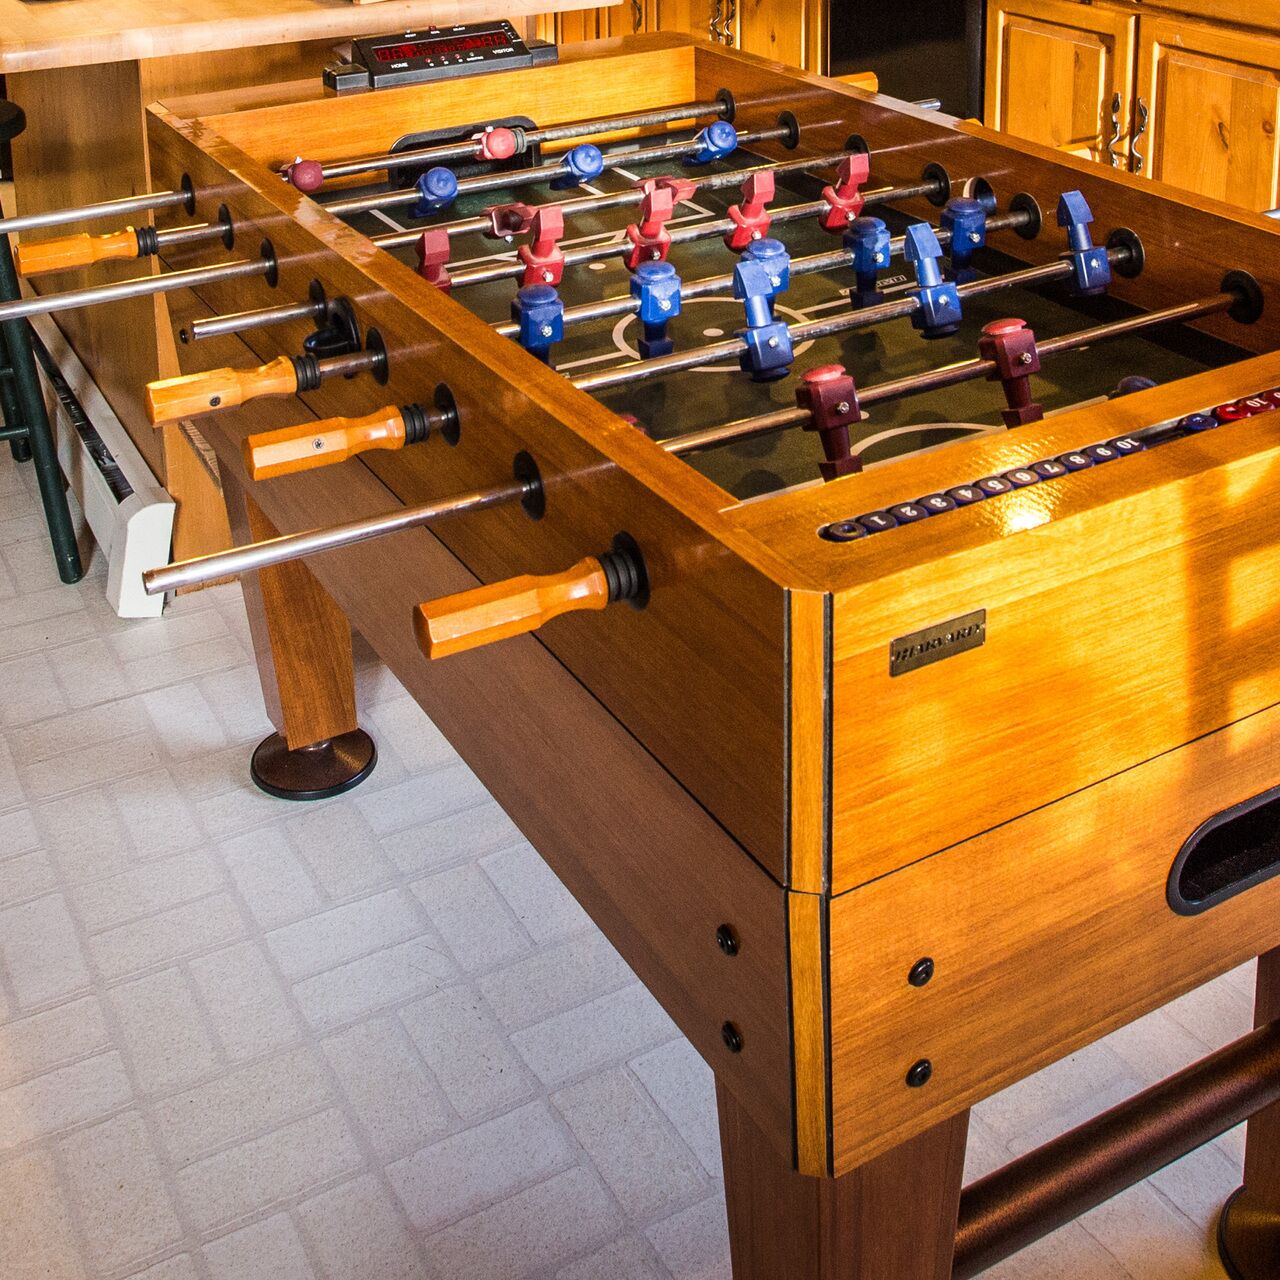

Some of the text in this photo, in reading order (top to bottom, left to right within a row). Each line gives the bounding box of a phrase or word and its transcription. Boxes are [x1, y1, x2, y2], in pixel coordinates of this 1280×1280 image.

[1246, 397, 1269, 409] 10
[870, 438, 1140, 526] 10 9 8 7 6 5 4 3 2 1
